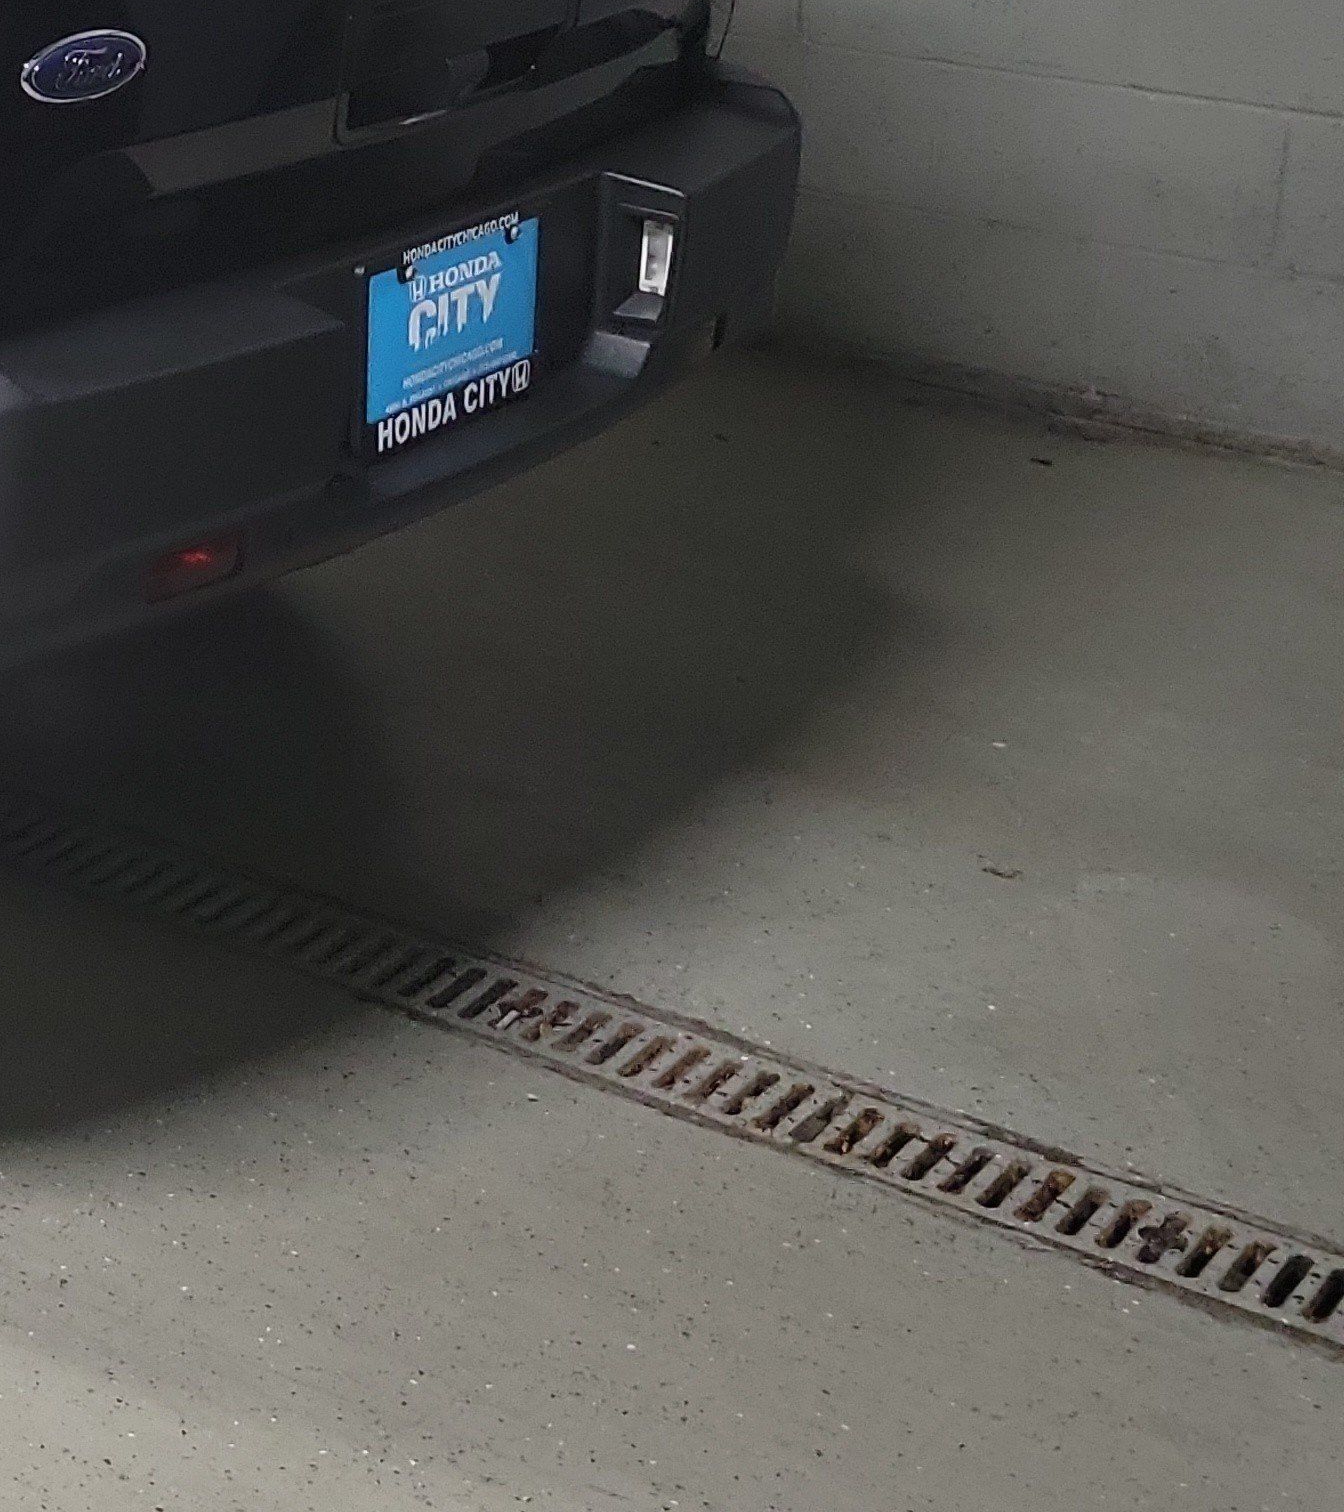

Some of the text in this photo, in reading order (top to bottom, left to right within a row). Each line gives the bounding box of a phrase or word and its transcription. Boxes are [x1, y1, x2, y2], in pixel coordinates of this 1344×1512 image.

[408, 271, 502, 352] CITY
[428, 251, 502, 292] HONDA
[377, 392, 457, 453] HONDA
[463, 366, 512, 414] CITY
